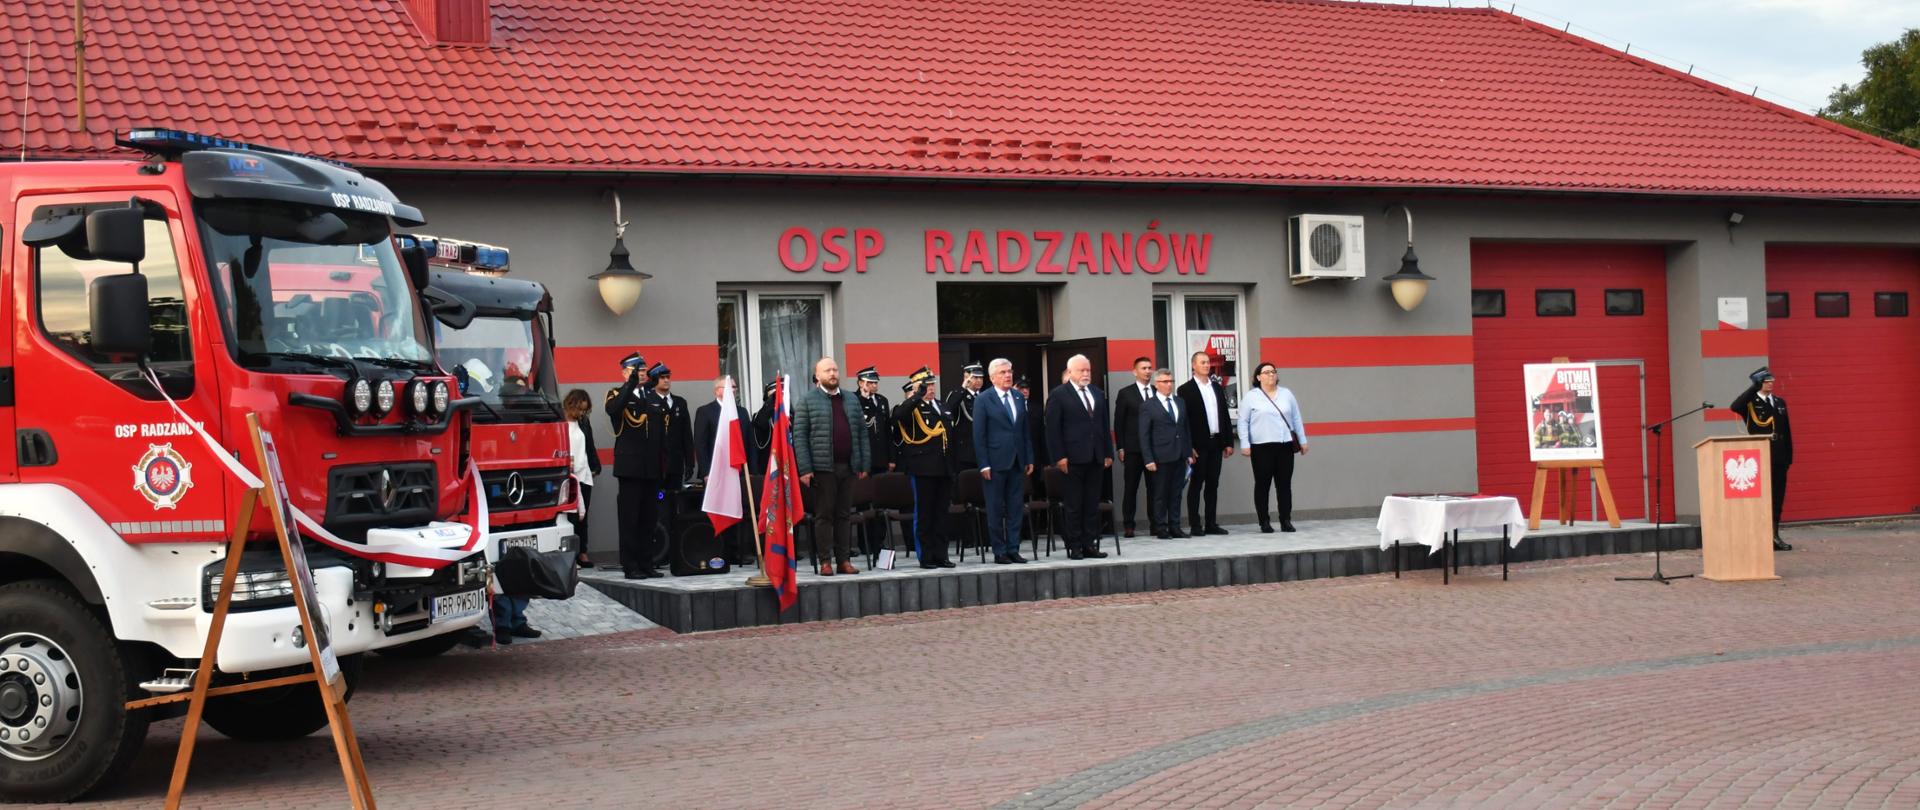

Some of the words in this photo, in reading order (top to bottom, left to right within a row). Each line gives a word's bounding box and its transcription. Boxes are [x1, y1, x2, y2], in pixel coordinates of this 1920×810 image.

[331, 192, 351, 208] OSP
[778, 226, 885, 274] OSP
[924, 218, 1214, 276] RADZANÓW
[1211, 336, 1235, 349] BITWA
[1557, 370, 1591, 384] BITWA
[115, 424, 138, 438] OSP
[437, 596, 454, 616] WBR
